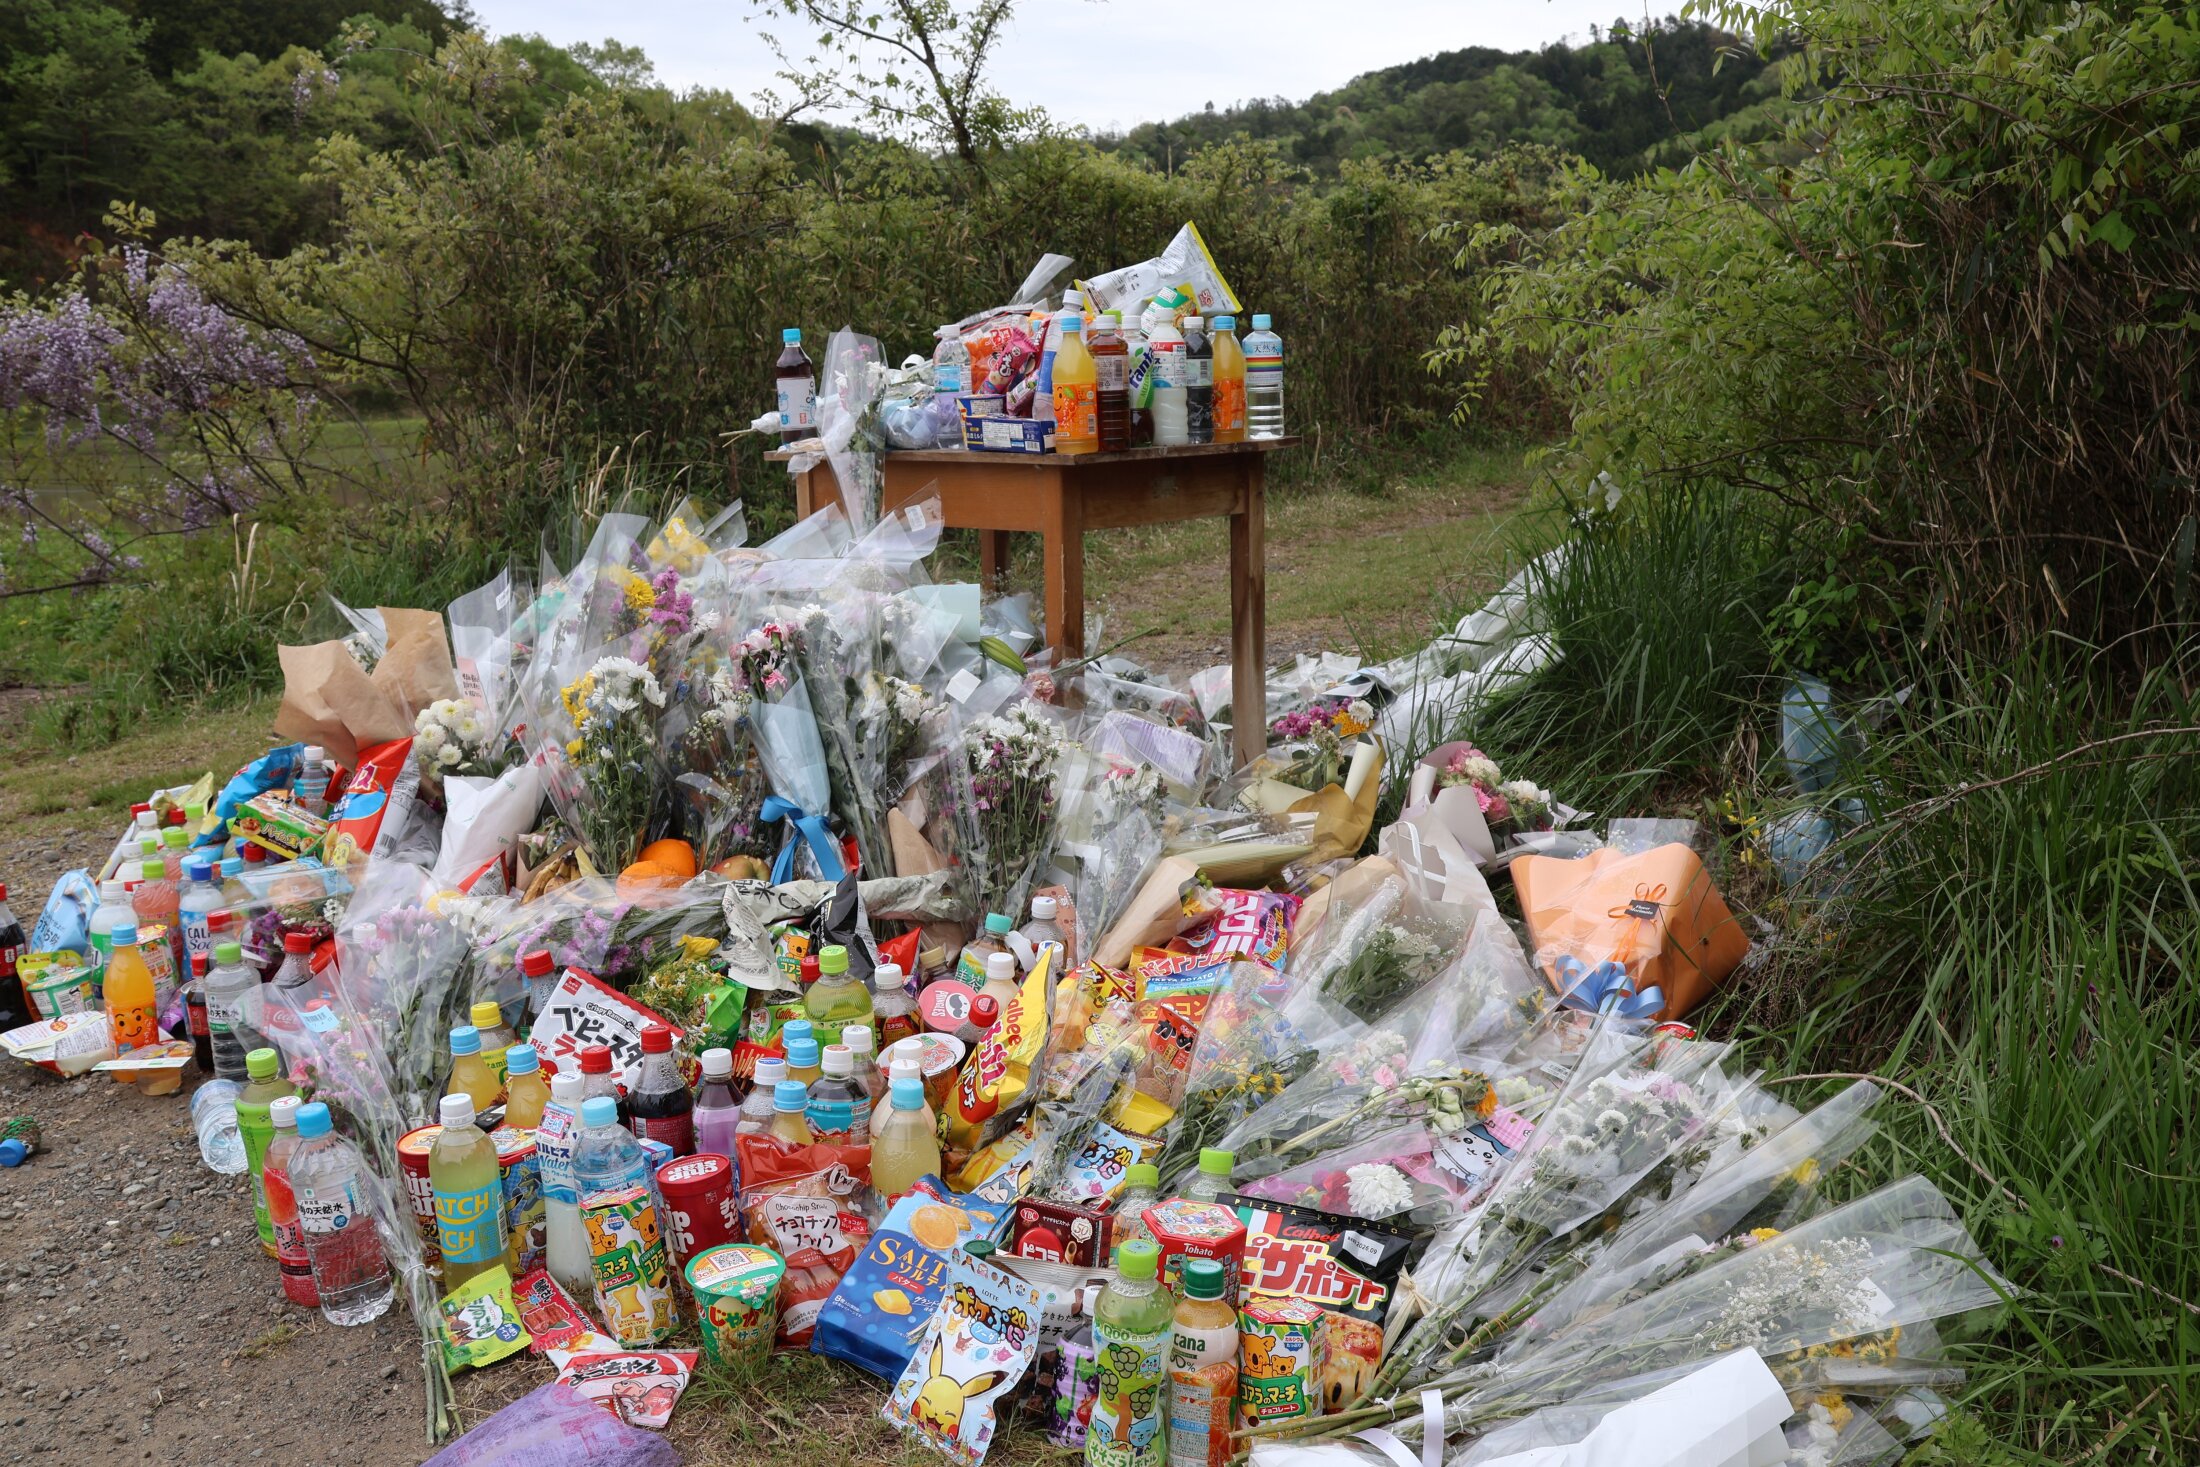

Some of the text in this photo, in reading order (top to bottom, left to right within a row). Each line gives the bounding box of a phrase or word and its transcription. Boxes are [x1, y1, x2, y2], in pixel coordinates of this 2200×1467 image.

[1254, 344, 1278, 354] 天然水
[1146, 976, 1178, 984] OIKEYA
[931, 990, 949, 1017] PRINGLES
[586, 1003, 609, 1016] Crispy
[606, 1008, 627, 1026] Ramen
[553, 1007, 645, 1069] ベビースタ
[962, 1065, 977, 1108] パンチ
[521, 1152, 538, 1163] Toha
[403, 1171, 432, 1198] hip
[436, 1191, 490, 1217] ATCH
[1023, 1208, 1038, 1220] YBC
[1233, 1198, 1297, 1216] PIZZA
[439, 1229, 475, 1250] TCH
[1073, 1223, 1090, 1236] 50
[1281, 1225, 1342, 1242] Calbee
[869, 1237, 948, 1274] SALT
[1022, 1241, 1061, 1264] ピコラ
[1183, 1242, 1214, 1257] Tohato
[643, 1249, 667, 1274] コアラ
[603, 1273, 633, 1288] チョコレート
[981, 1288, 999, 1302] LOTTE
[709, 1299, 775, 1330] じゃがり
[974, 1324, 997, 1342] ソーダ
[1102, 1323, 1130, 1341] Qoo
[1173, 1332, 1207, 1353] cana
[568, 1359, 661, 1387] よっちゃん
[1240, 1384, 1297, 1405] コアラのマーチ
[1260, 1405, 1297, 1415] チョコレート
